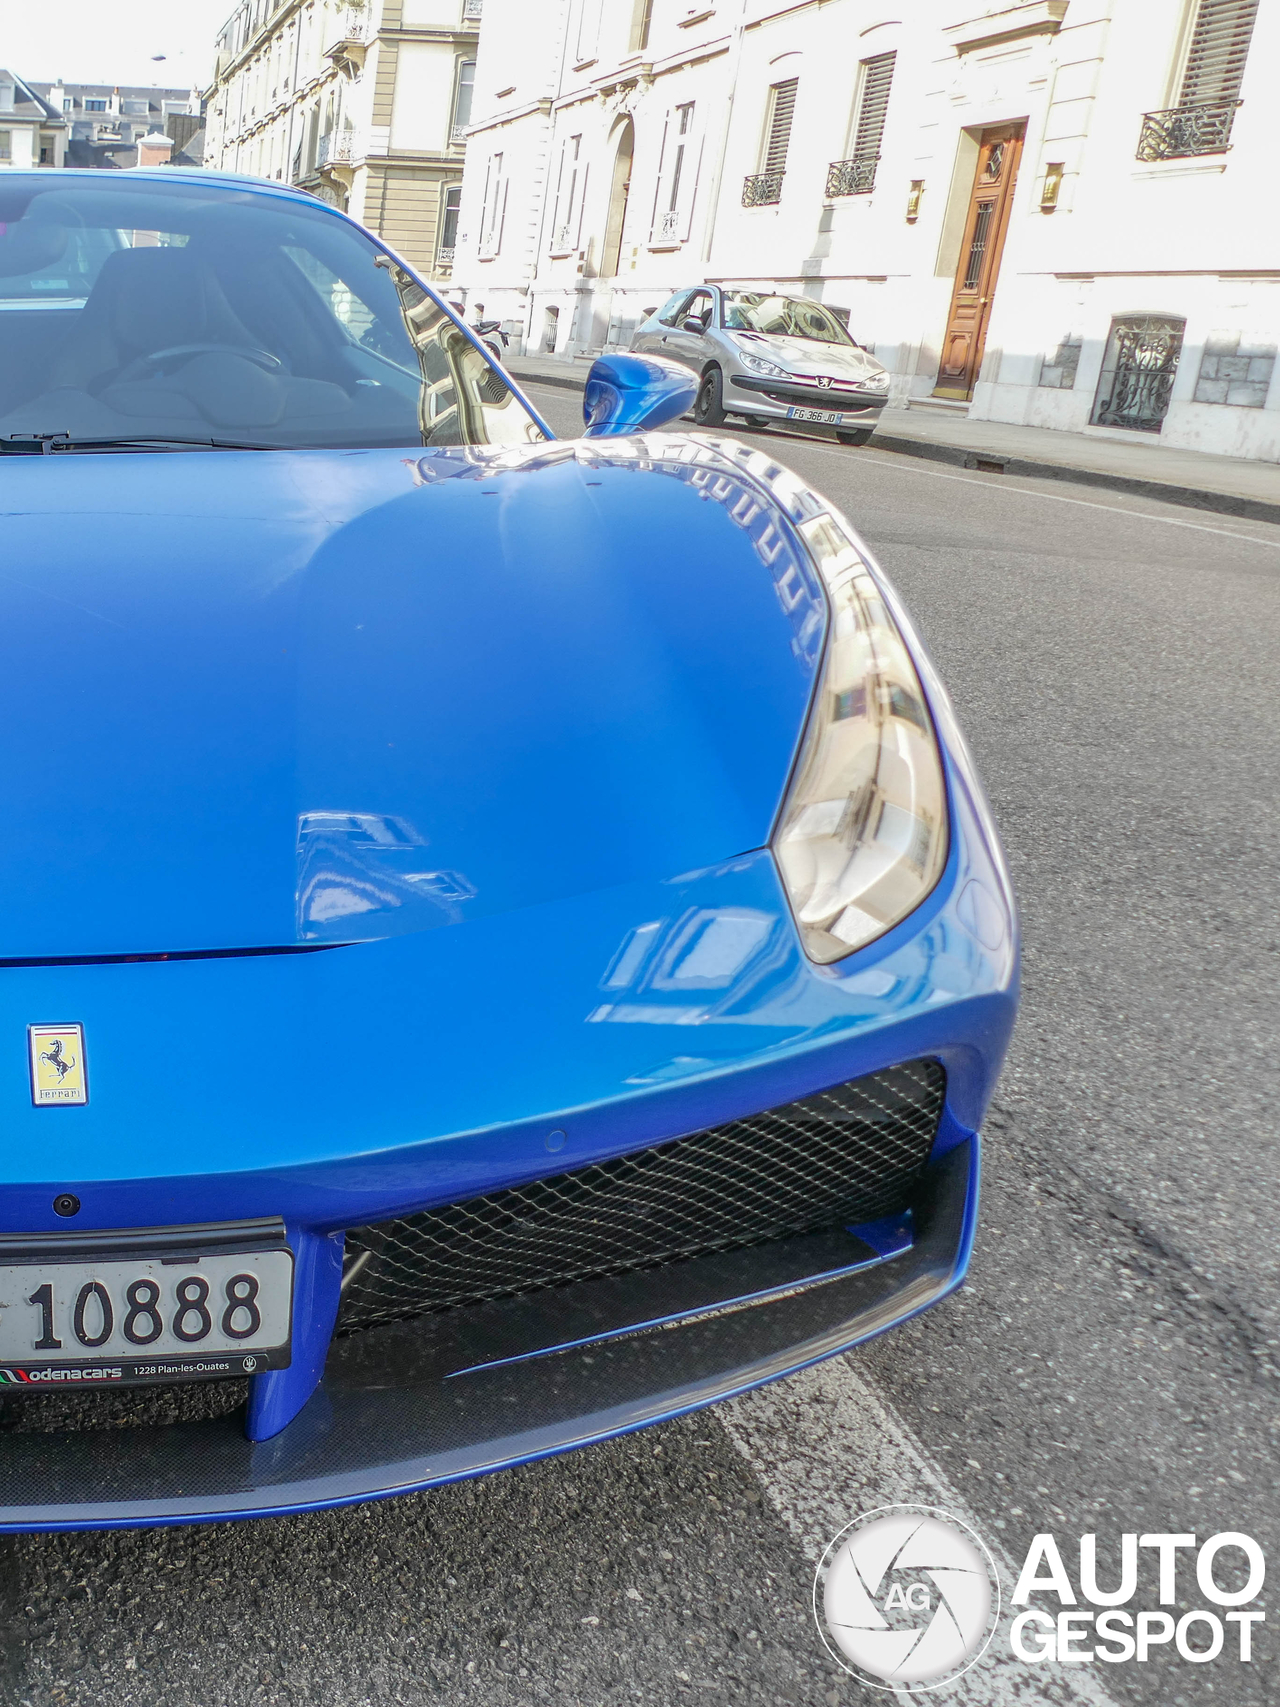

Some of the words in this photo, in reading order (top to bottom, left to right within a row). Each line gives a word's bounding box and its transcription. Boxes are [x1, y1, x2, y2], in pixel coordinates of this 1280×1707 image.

[793, 409, 805, 418] FG
[807, 411, 822, 420] 366
[28, 1272, 263, 1350] 10888
[133, 1366, 156, 1375] 1228
[157, 1362, 230, 1375] Plan-les-Ouates
